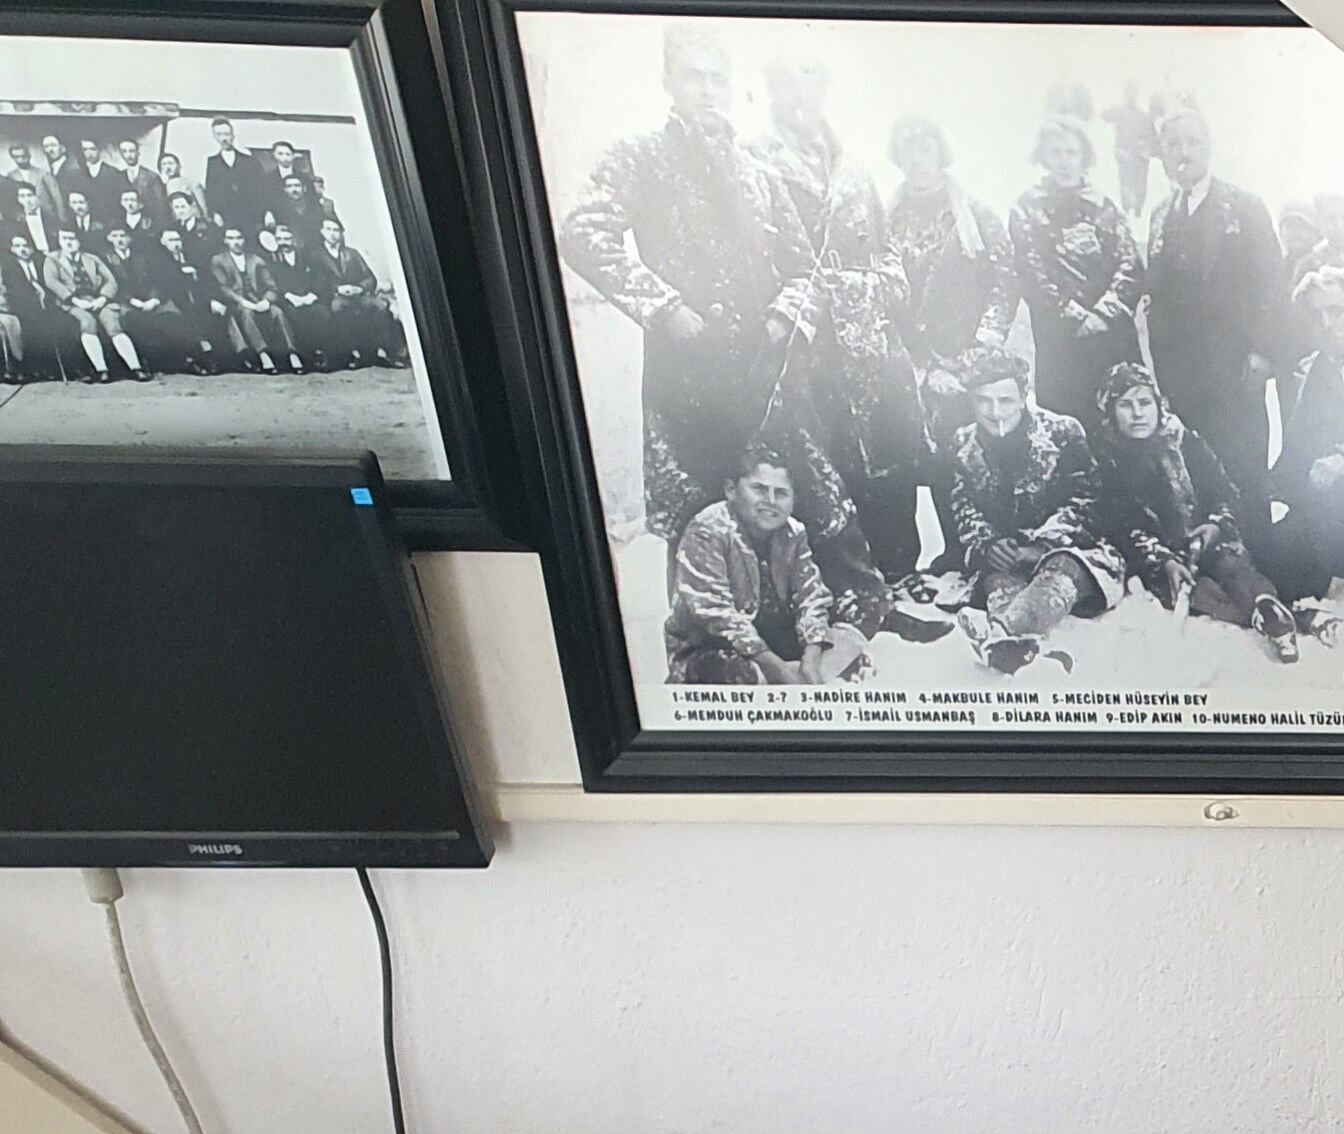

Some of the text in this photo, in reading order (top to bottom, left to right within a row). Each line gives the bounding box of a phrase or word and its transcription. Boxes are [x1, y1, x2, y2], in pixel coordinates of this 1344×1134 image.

[672, 691, 727, 703] 1-KEMAL
[731, 691, 755, 703] BEY
[800, 688, 861, 704] 3-NADİRE
[865, 691, 906, 704] HANIM
[918, 692, 992, 704] 4-MAKBULE
[997, 692, 1039, 705] HANIM
[1125, 690, 1179, 706] HÜSEYİN
[1183, 694, 1208, 706] BEY
[674, 709, 743, 721] 6-MEMDUH
[747, 706, 833, 725] ÇAKMAKOĞLU
[845, 707, 902, 722] 7-İSMAİL
[992, 709, 1050, 724] 8-DİLARA
[1055, 711, 1097, 725] HANIM
[1105, 709, 1148, 725] 9-EDİP
[1152, 711, 1182, 725] AKIN
[1270, 710, 1306, 725] HALİL
[187, 843, 243, 855] PHILIPS
